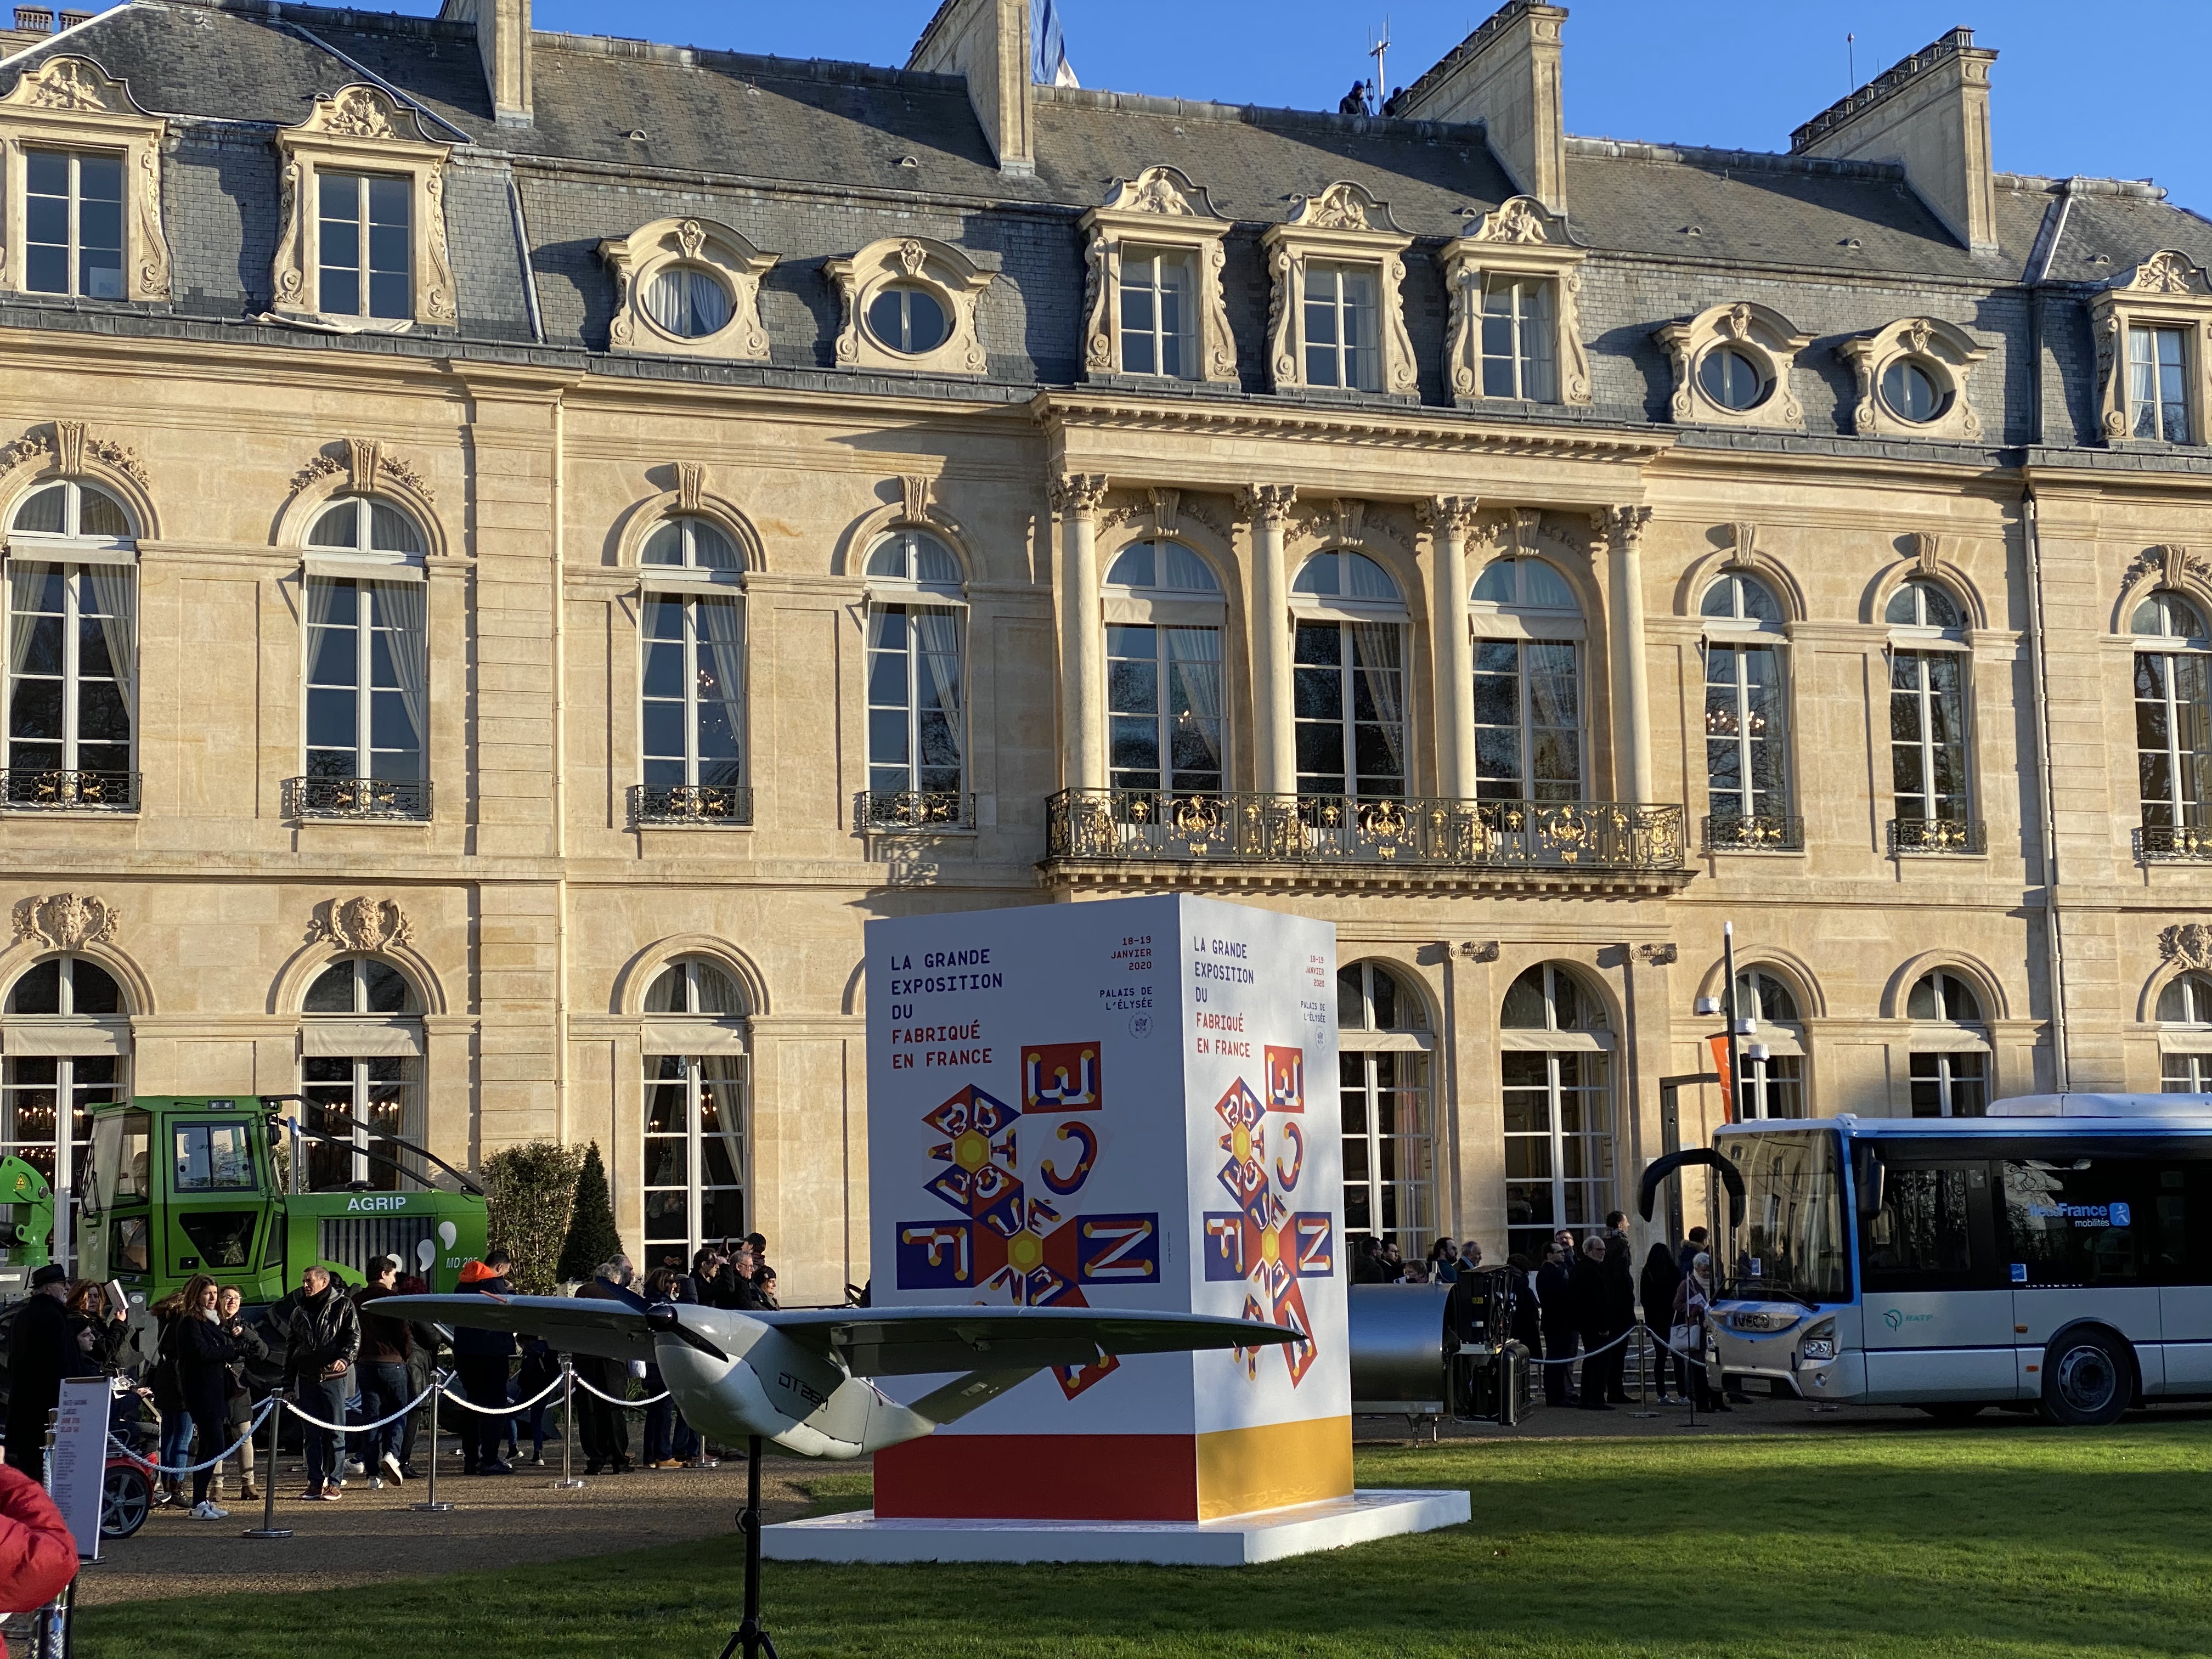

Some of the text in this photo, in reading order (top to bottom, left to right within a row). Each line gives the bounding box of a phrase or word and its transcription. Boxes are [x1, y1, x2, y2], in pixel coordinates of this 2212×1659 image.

[1122, 935, 1152, 946] 18-19
[1110, 948, 1152, 960] JANVIER
[1194, 936, 1248, 960] LA GRANDE
[891, 948, 990, 971] LA GRANDE
[1128, 961, 1152, 970] 2020
[1310, 955, 1324, 964] 18-19
[1194, 961, 1254, 985] EXPOSITION
[1305, 966, 1325, 976] JANVIER
[891, 972, 1003, 996] EXPOSITION
[1313, 979, 1325, 988] 2020
[1099, 986, 1153, 998] PALAIS DE
[1195, 986, 1207, 1003] DU
[1105, 997, 1153, 1011] L'ÉLYSÉE
[1301, 1000, 1325, 1012] PALAIS DE
[891, 1003, 912, 1020] DU
[1304, 1012, 1326, 1024] L'ÉLYSÉE
[1196, 1012, 1244, 1032] FABRIQUÉ
[892, 1019, 980, 1045] FABRIQUÉ
[1197, 1037, 1251, 1058] EN FRANCE
[893, 1047, 992, 1069] EN FRANCE
[347, 1197, 407, 1211] AGRIP
[2075, 1217, 2110, 1227] mobilités
[445, 1257, 460, 1268] MD
